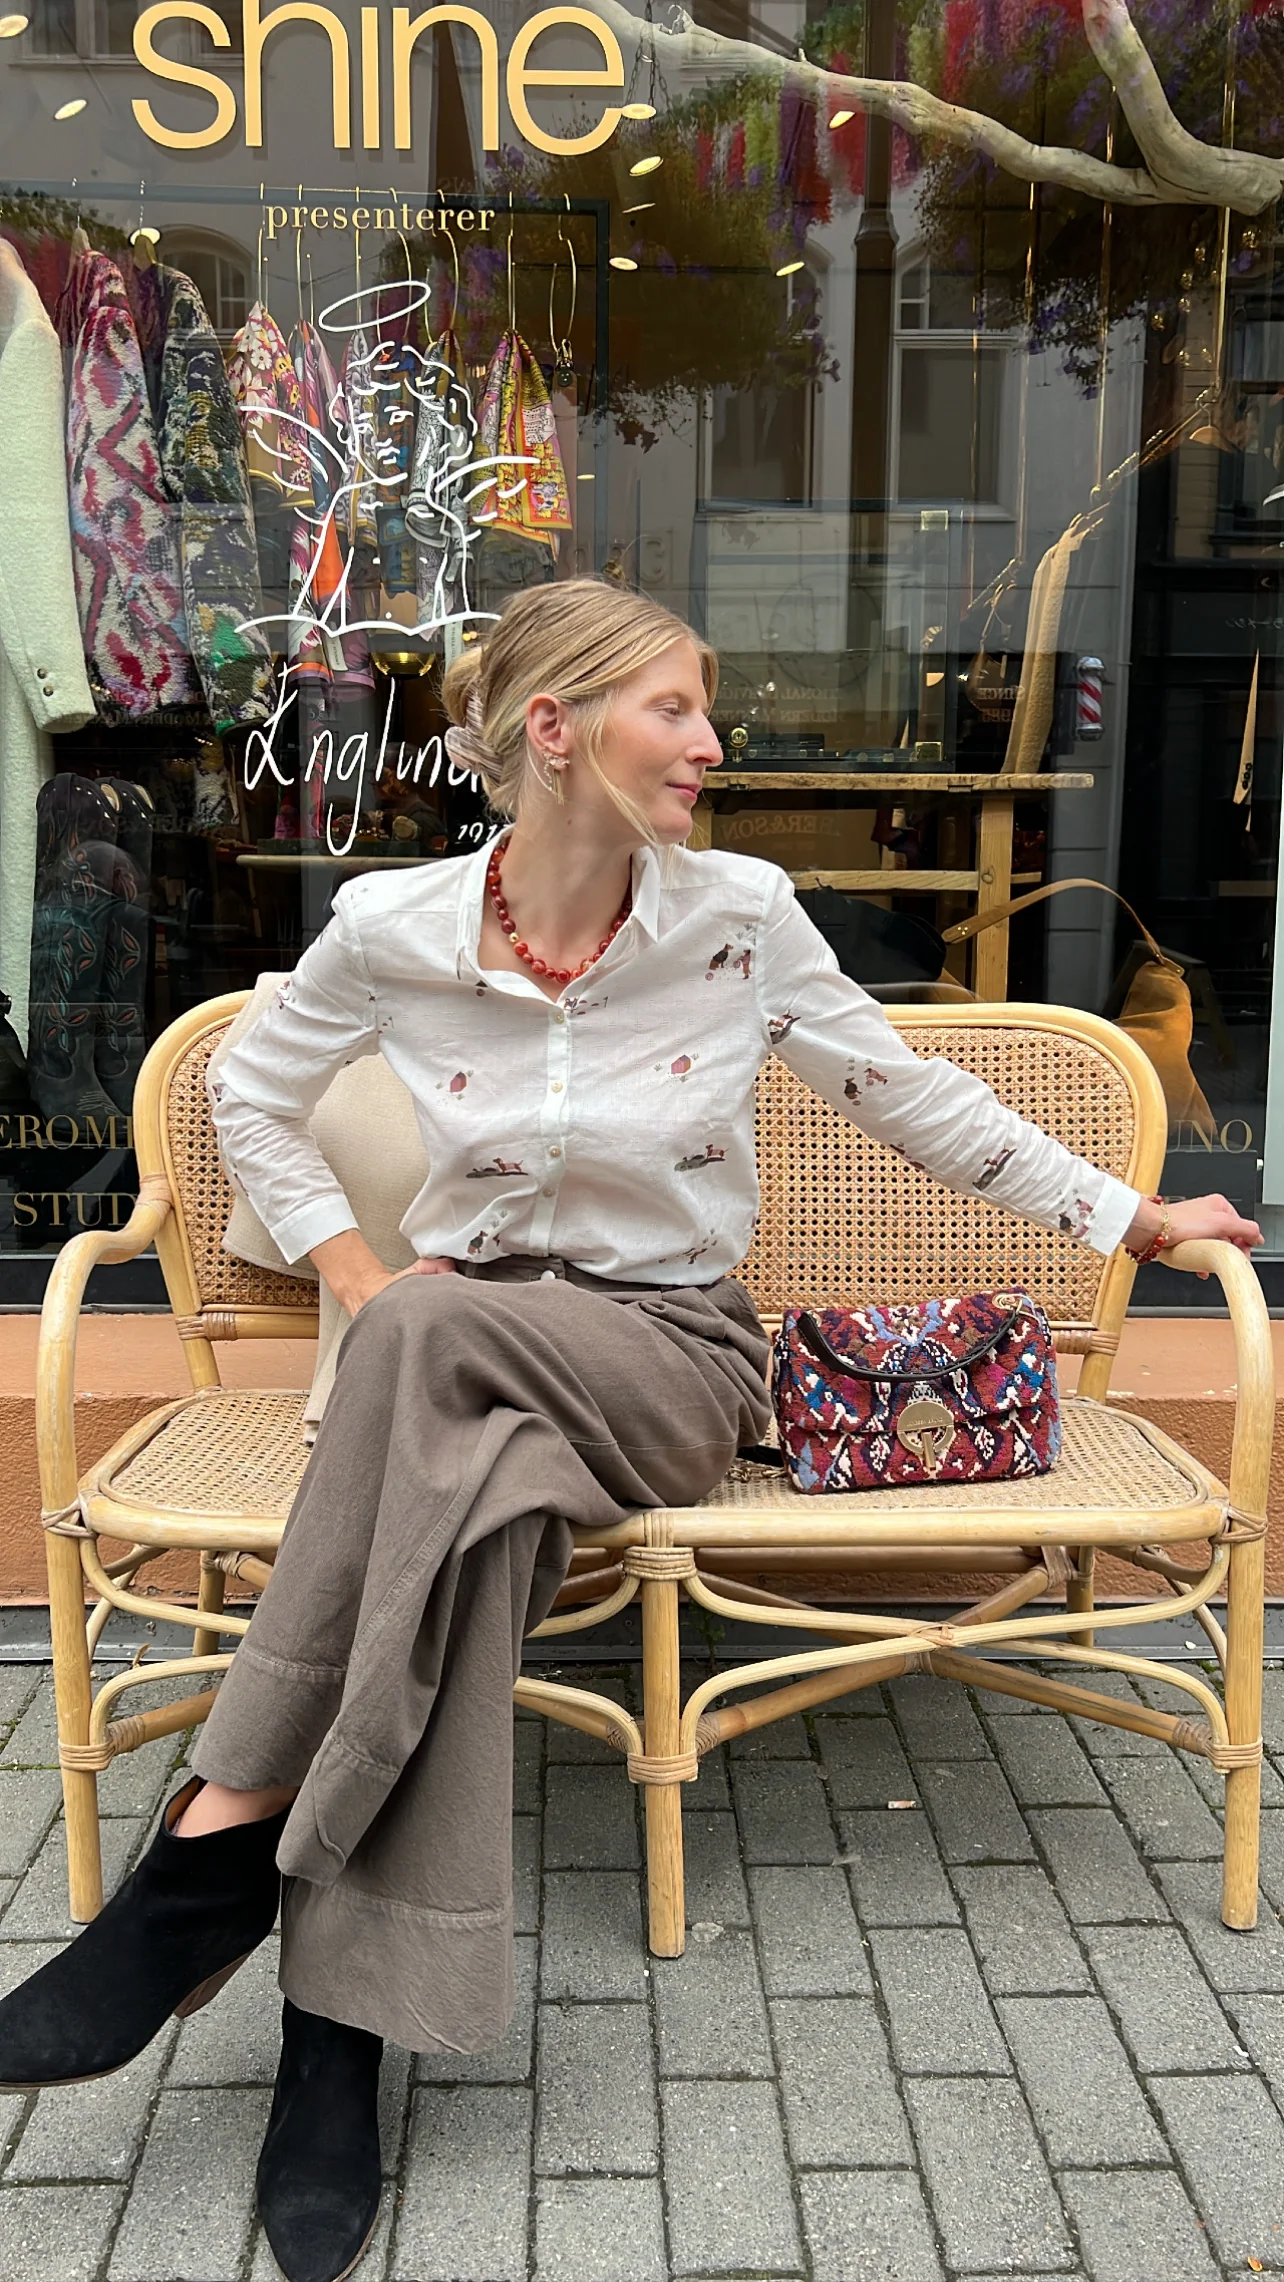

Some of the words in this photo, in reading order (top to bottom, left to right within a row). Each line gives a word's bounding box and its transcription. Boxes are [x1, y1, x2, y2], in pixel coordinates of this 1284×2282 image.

[131, 0, 625, 156] shine
[265, 203, 496, 240] presenterer
[457, 822, 509, 843] 191
